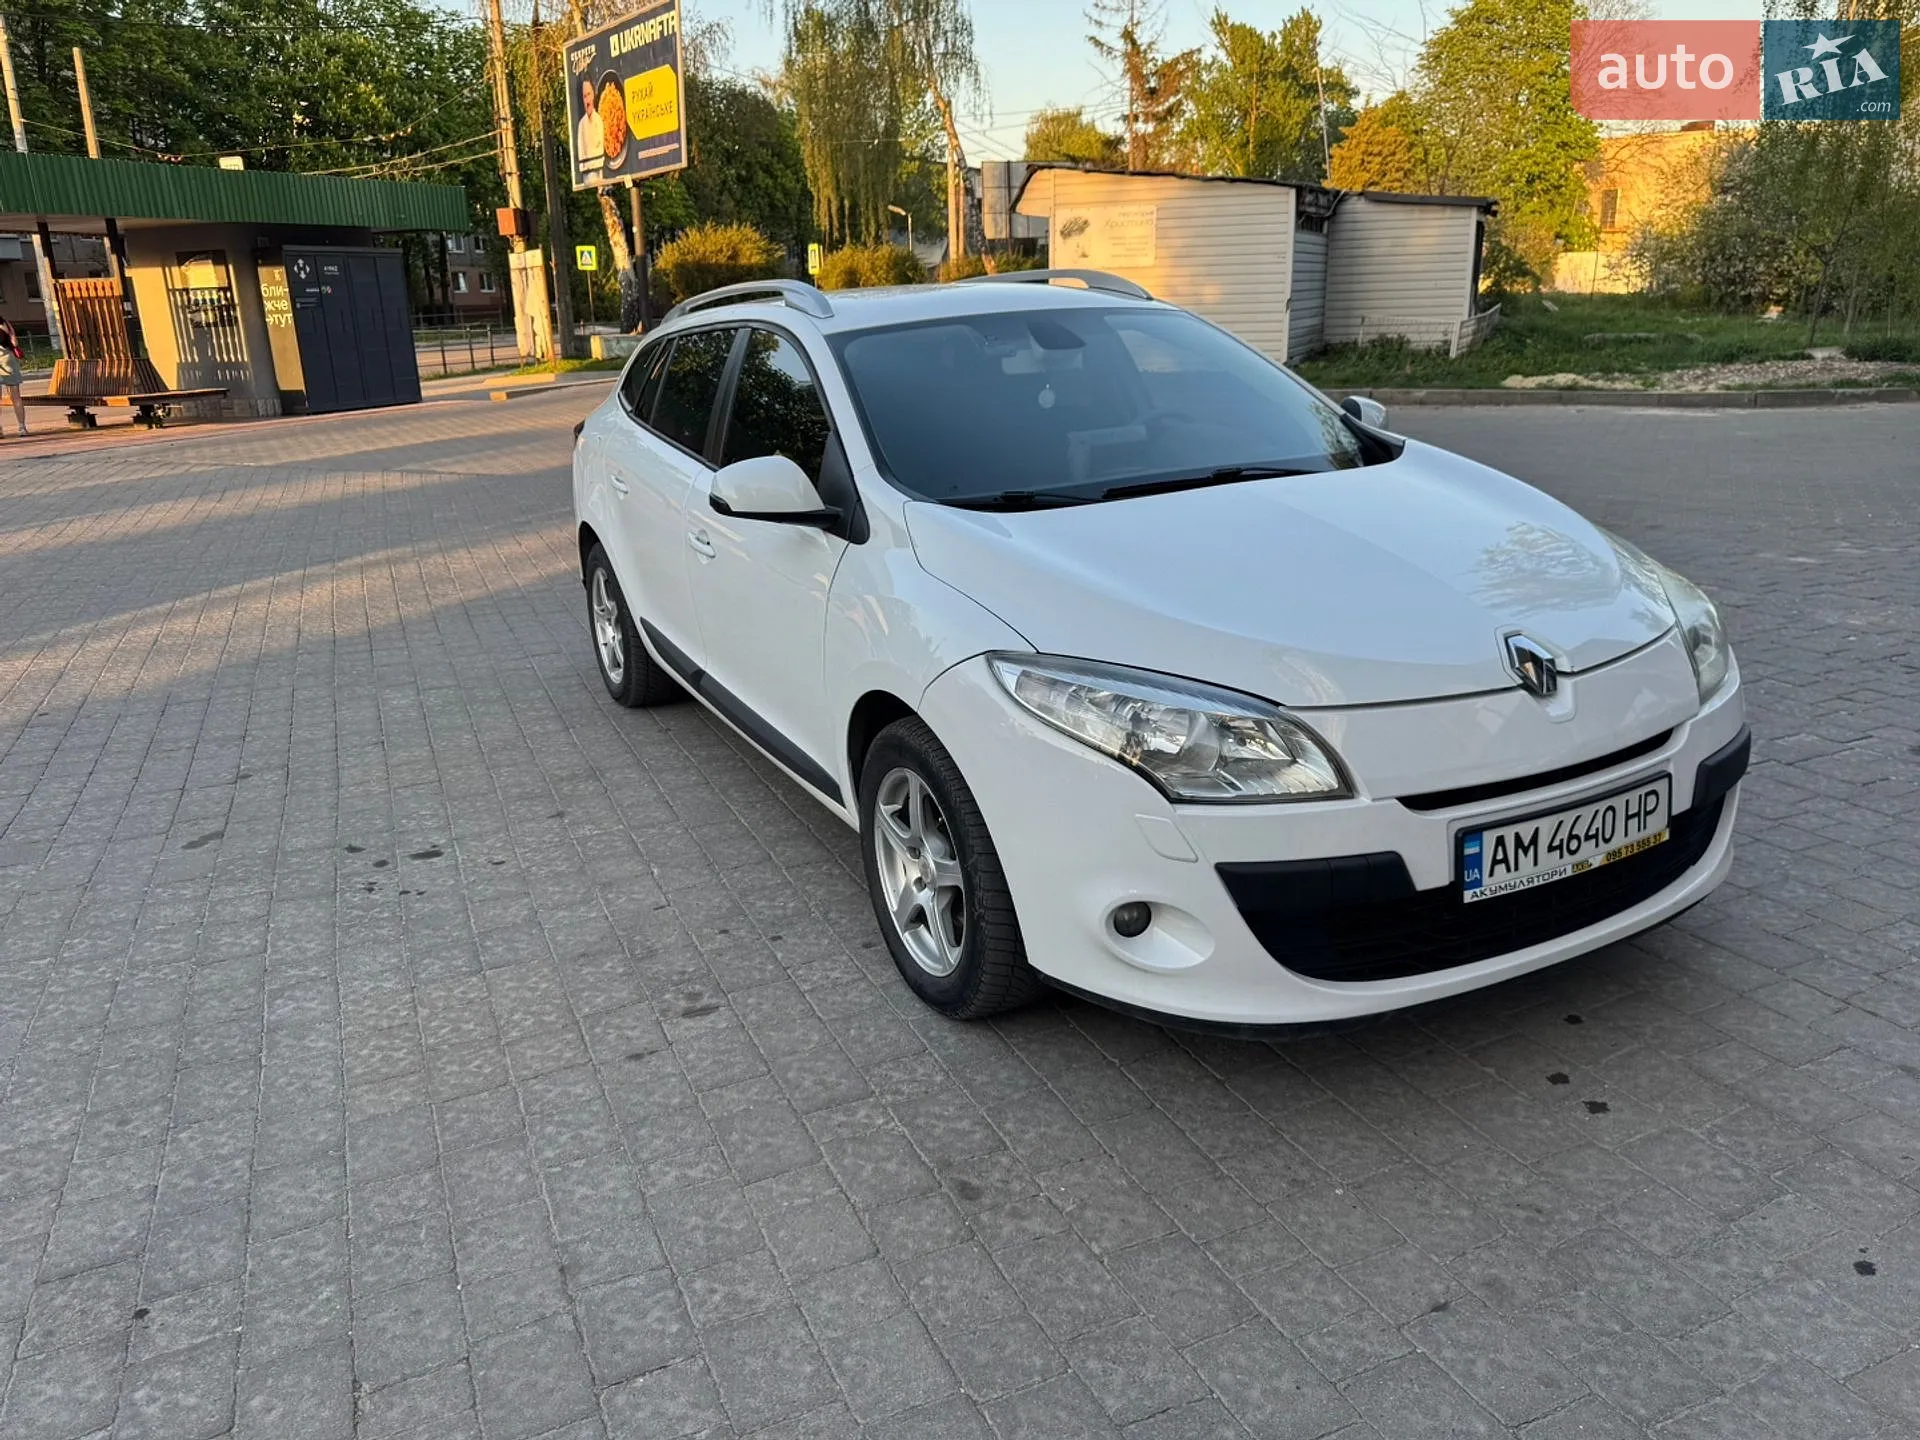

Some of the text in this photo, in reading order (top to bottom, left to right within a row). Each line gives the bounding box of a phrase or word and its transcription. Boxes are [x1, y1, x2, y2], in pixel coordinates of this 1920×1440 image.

[621, 10, 677, 54] UKRNAFTA
[264, 299, 289, 311] жче
[1488, 788, 1660, 878] AM 4640 HP
[1606, 847, 1623, 862] 095
[1623, 842, 1635, 856] 73
[1464, 867, 1480, 883] UA
[1470, 867, 1568, 900] АКУМУЛЯТОРИ
